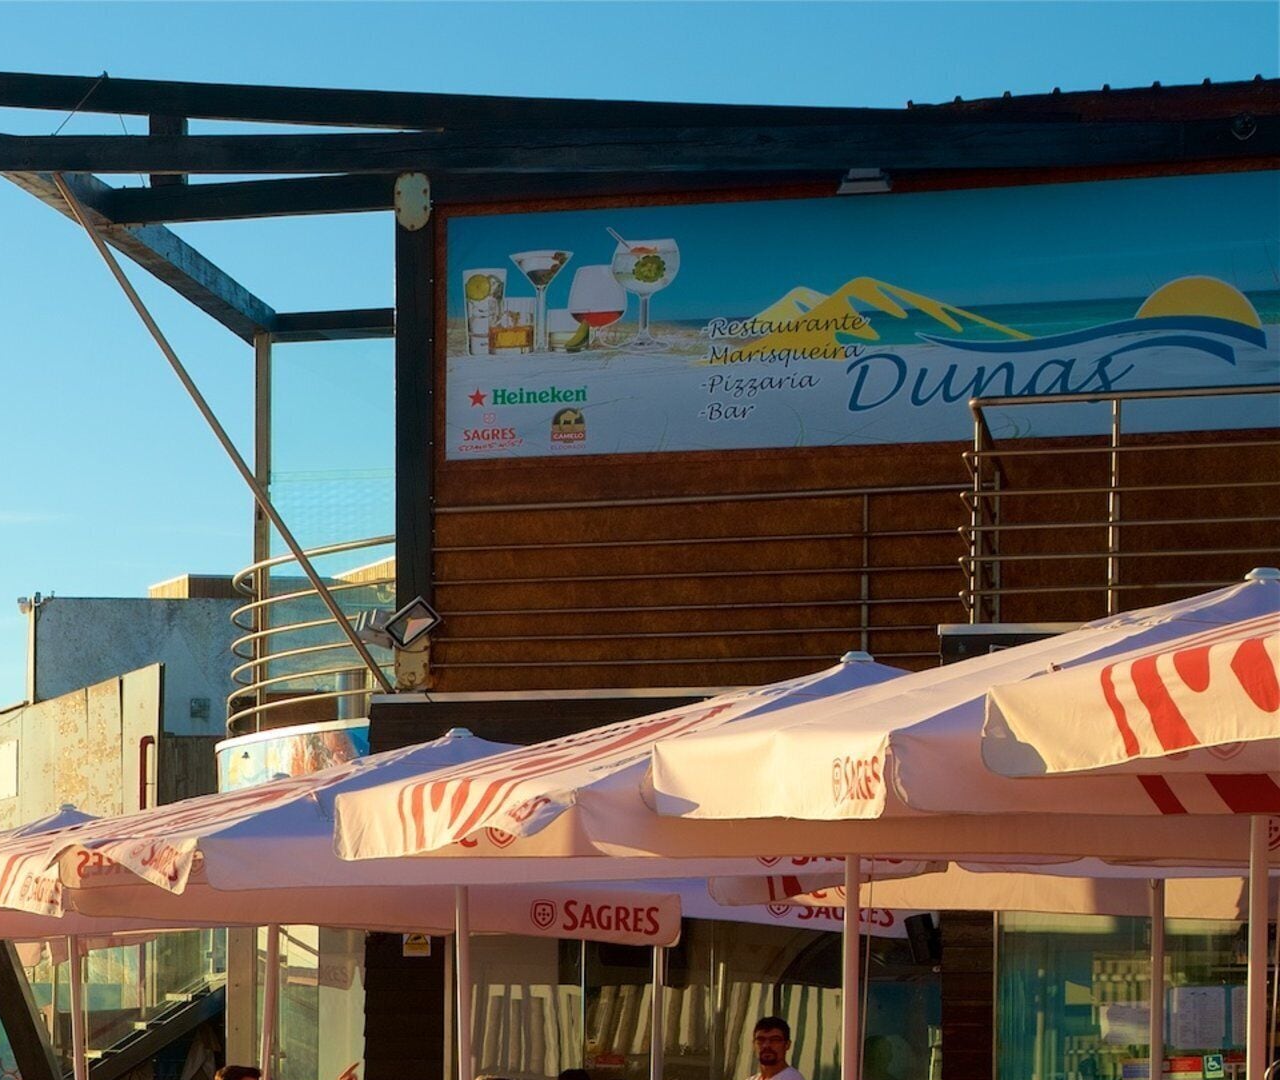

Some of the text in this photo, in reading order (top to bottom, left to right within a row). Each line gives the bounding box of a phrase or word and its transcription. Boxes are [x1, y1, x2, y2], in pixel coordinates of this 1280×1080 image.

[492, 386, 587, 405] Heineken
[846, 352, 1135, 412] Dunas
[463, 428, 516, 441] SAGRES
[562, 900, 660, 935] SAGRES
